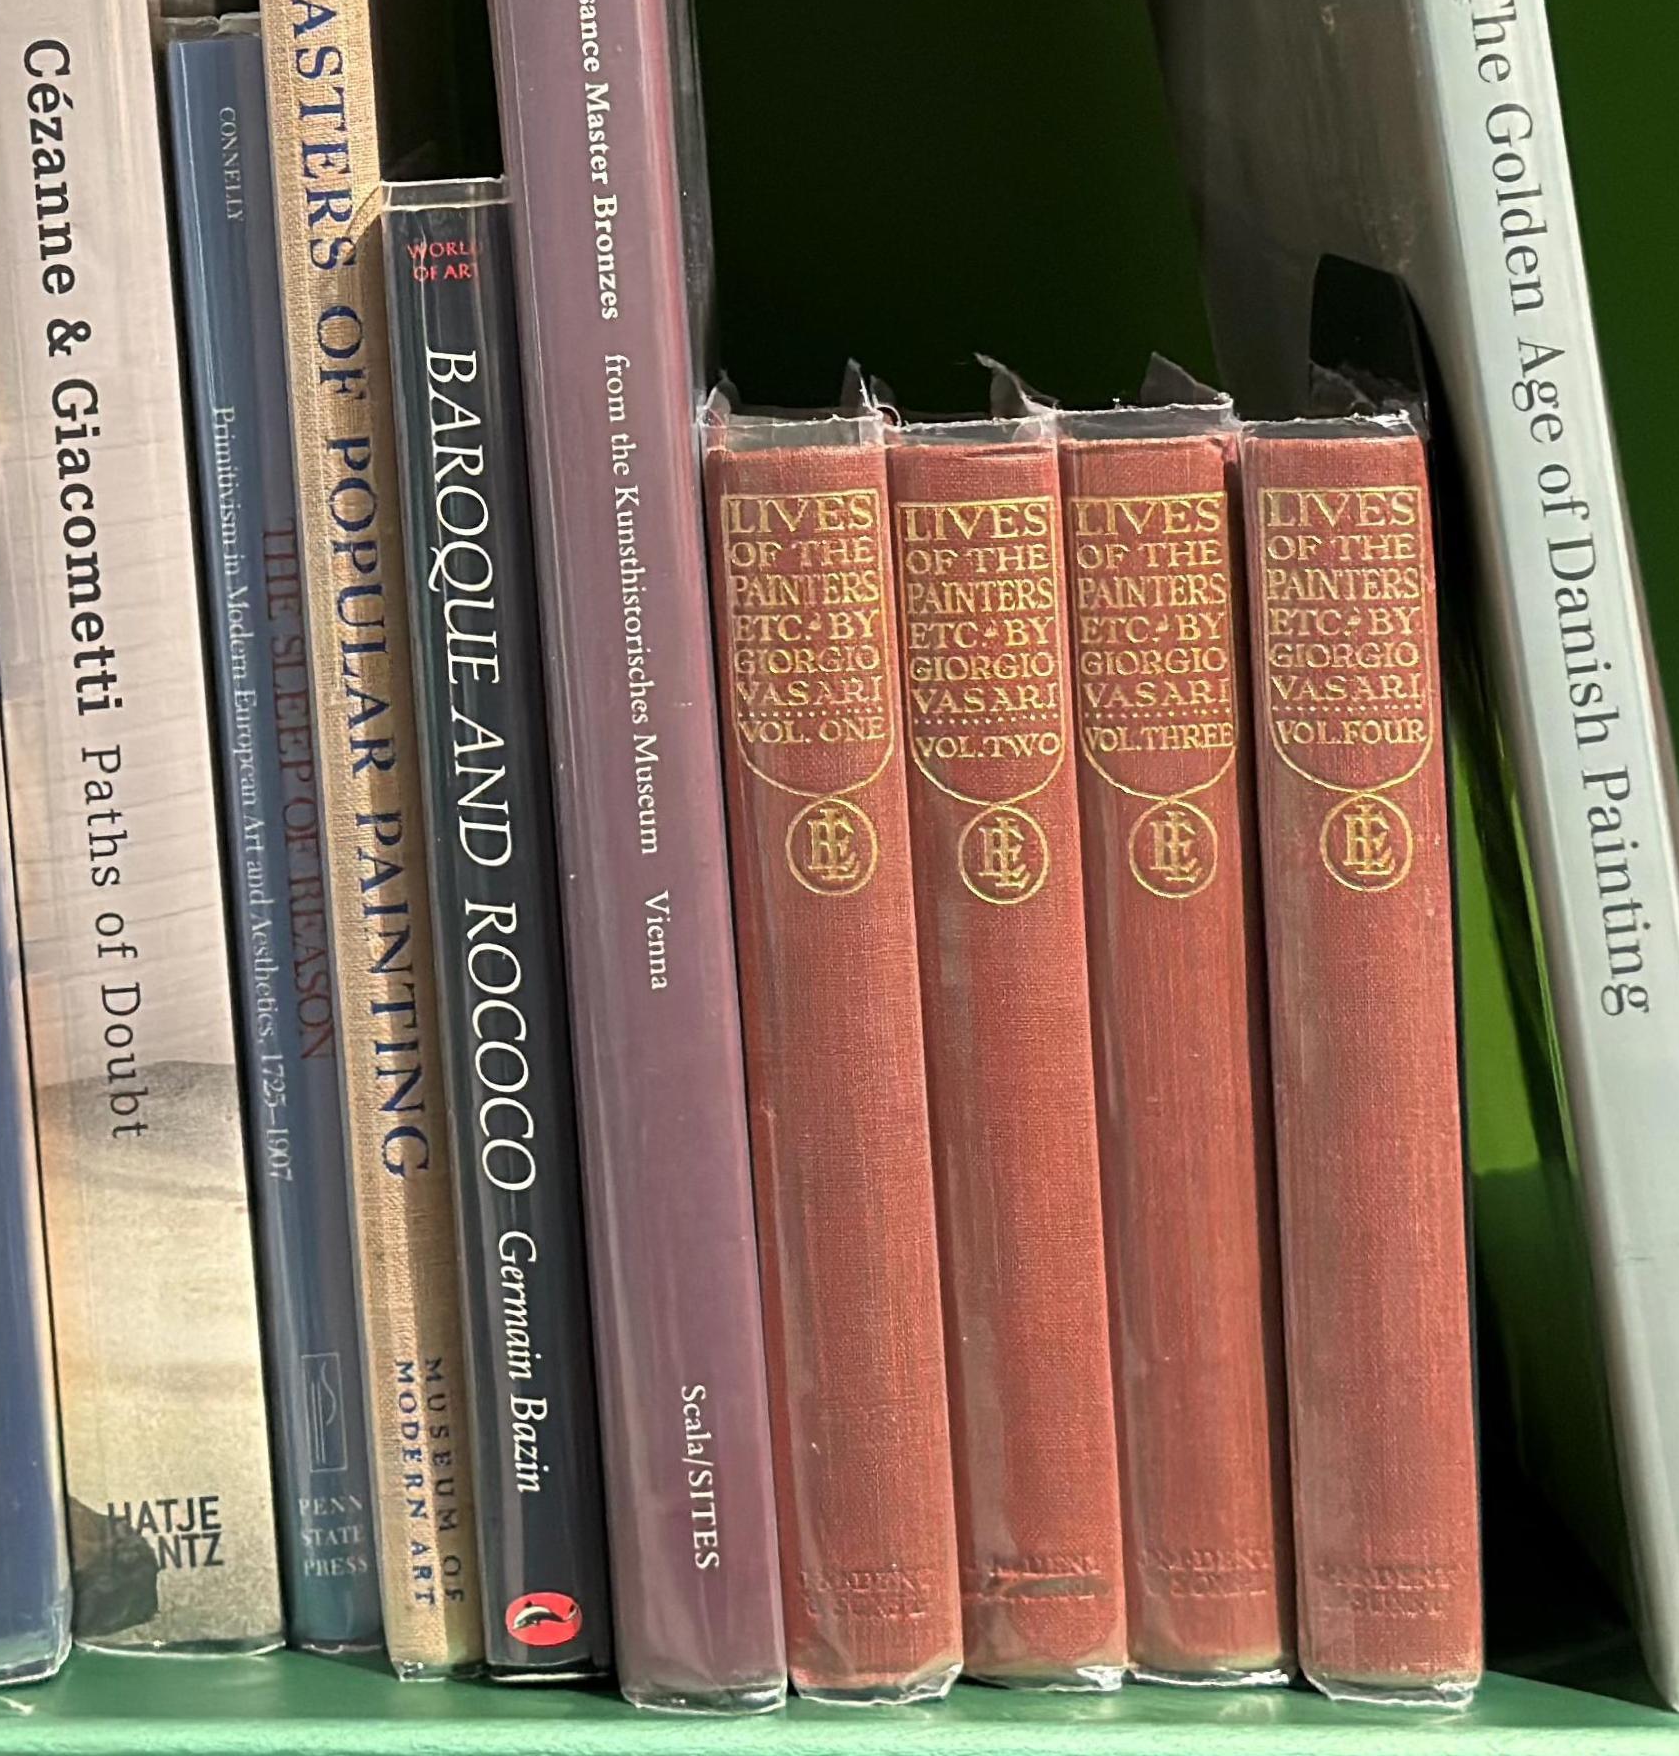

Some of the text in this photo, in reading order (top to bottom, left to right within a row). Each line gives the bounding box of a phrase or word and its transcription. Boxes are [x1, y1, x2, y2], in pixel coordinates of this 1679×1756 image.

[584, 80, 611, 185] Master
[218, 106, 245, 222] CONNELLY
[1484, 101, 1549, 316] Golden
[412, 265, 439, 283] OF
[593, 193, 619, 322] Bronzes
[315, 304, 365, 402] OF
[604, 352, 630, 425] from
[1511, 335, 1567, 444] Age
[610, 430, 631, 476] the
[213, 405, 242, 545] Primitivism
[1537, 462, 1589, 522] of
[728, 493, 876, 535] LIVES
[904, 503, 1048, 542] LIVES
[1075, 499, 1221, 537] LIVES
[1266, 492, 1417, 528] LIVES
[223, 553, 247, 576] in
[730, 537, 875, 569] OF THE
[906, 544, 1050, 575] OF THE
[1076, 538, 1224, 570] OF THE
[1267, 533, 1416, 563] OF THE
[23, 38, 149, 1139] Cézanne & Giacometti Paths of Doubt
[731, 569, 881, 608] PAINTERS
[906, 577, 1054, 615] PAINTERS
[1077, 572, 1227, 610] PAINTERS
[1266, 564, 1421, 601] PAINTERS
[325, 435, 398, 778] POPULAR
[613, 483, 658, 726] Kunsthistorisches
[829, 608, 881, 640] BY
[1368, 605, 1422, 635] BY
[226, 585, 255, 680] Modern
[1004, 616, 1055, 648] BY
[1177, 612, 1225, 643] BY
[1545, 532, 1621, 751] Danish
[734, 644, 882, 676] GIORGIO
[909, 651, 1056, 682] GIORGIO
[1080, 646, 1228, 677] GIORGIO
[1268, 641, 1420, 670] GIORGIO
[736, 675, 884, 708] VASARI
[912, 683, 1059, 716] VASARI
[1081, 677, 1231, 709] VASARI
[1271, 672, 1422, 702] VASARI
[232, 688, 260, 805] European
[738, 714, 886, 745] VOL. ONE
[262, 518, 336, 1061] THE SLEEP OF REASON
[632, 732, 660, 856] Museum
[241, 814, 267, 853] Art
[246, 860, 274, 906] and
[1580, 765, 1653, 1018] Painting
[425, 348, 550, 1496] BAROQUE AND ROCOCO Germain Bazin
[642, 889, 670, 992] Vienna
[355, 810, 431, 1179] PAINTING
[395, 1358, 437, 1607] MODERN ART
[425, 1355, 465, 1604] MUSEUM OF
[680, 1384, 720, 1571] Scala/SITES
[106, 1495, 223, 1536] HATJE
[298, 1494, 364, 1515] PENN
[300, 1524, 366, 1546] STATE
[302, 1556, 369, 1578] PRESS
